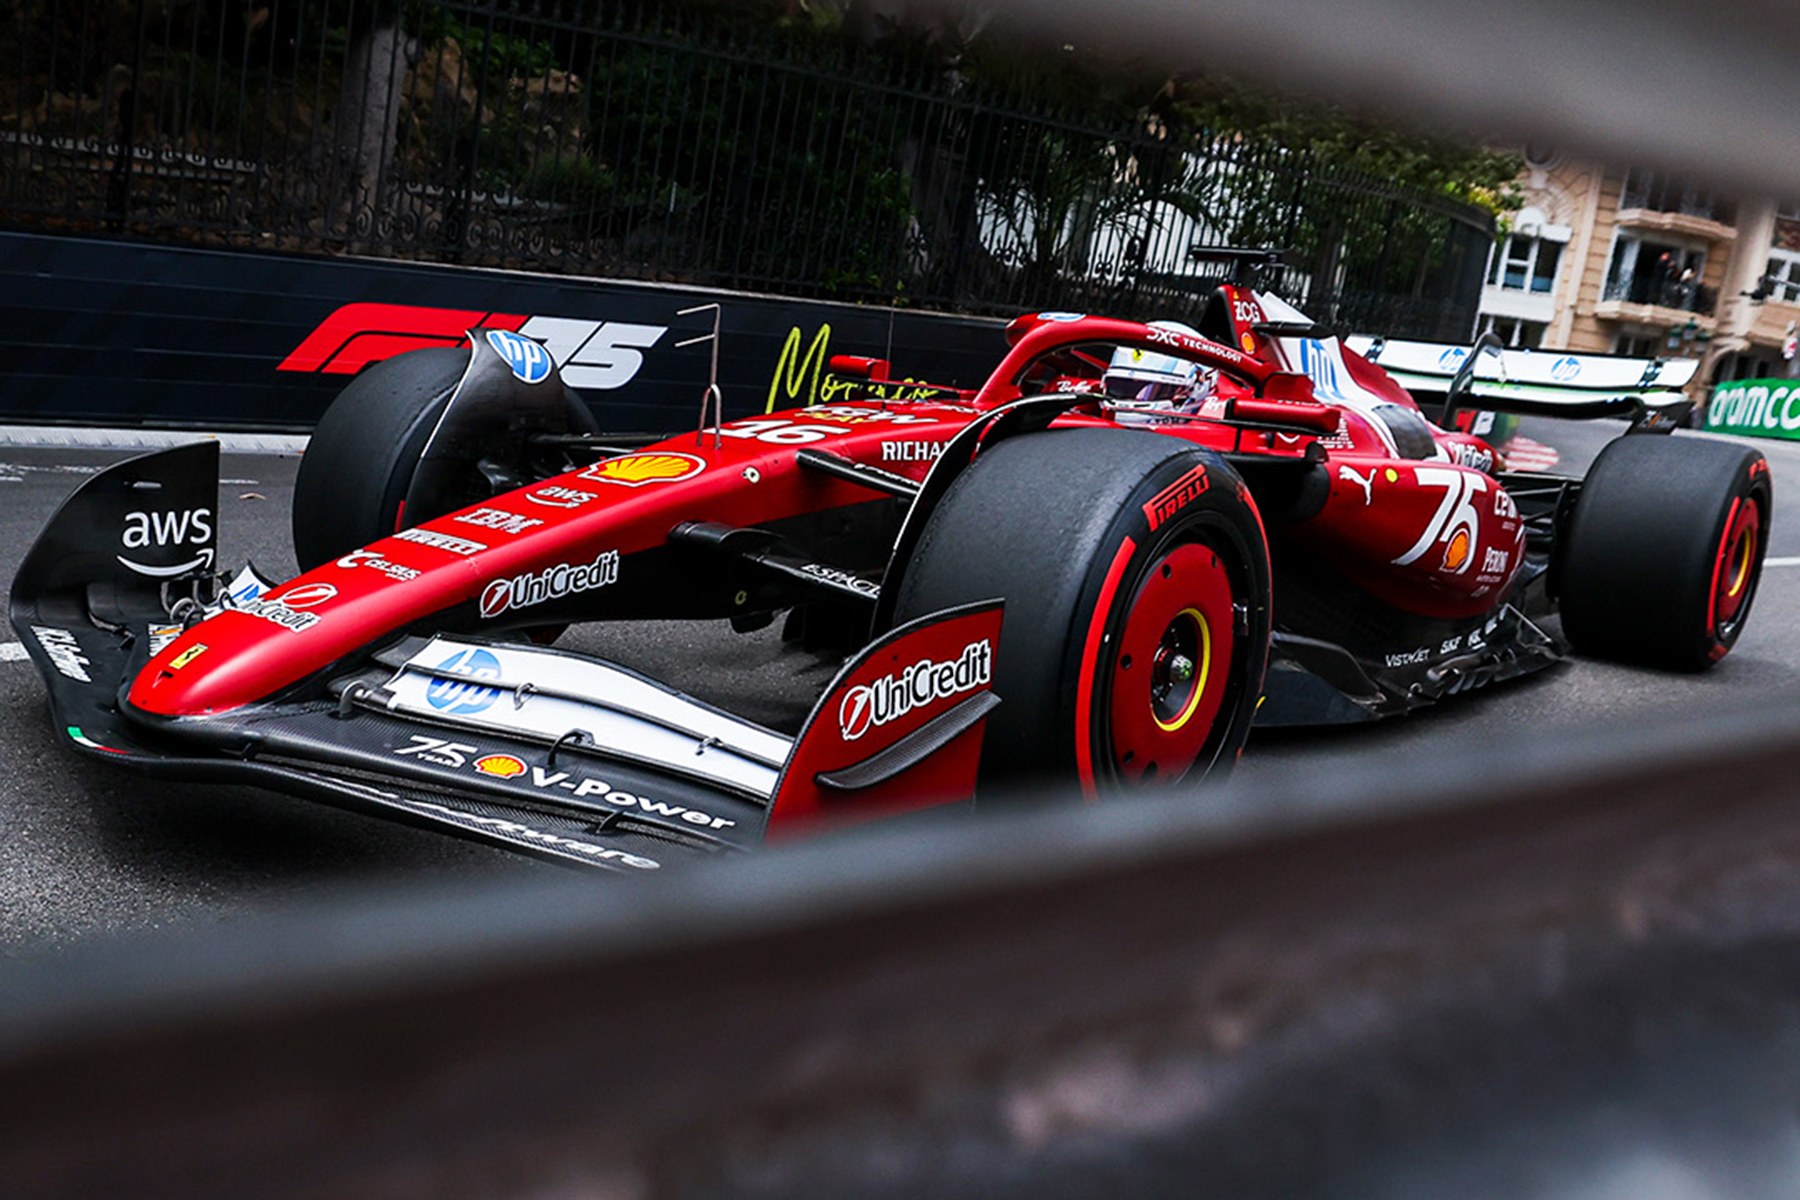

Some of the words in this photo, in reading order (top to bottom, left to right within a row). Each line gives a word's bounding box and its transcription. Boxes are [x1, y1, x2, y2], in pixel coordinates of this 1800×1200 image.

[491, 329, 552, 384] hp
[1146, 327, 1180, 347] DXC
[1183, 338, 1243, 364] TECHNOLOGY
[703, 419, 852, 444] 16
[881, 440, 949, 461] RICHA
[536, 486, 599, 503] aws
[1142, 464, 1211, 533] PIRELLI
[121, 507, 212, 548] aws
[453, 507, 545, 534] IBM
[1391, 468, 1487, 575] 75
[511, 549, 620, 609] UniCredit
[871, 638, 992, 707] UniCredit
[393, 734, 479, 767] 75
[531, 766, 736, 829] V-Power
